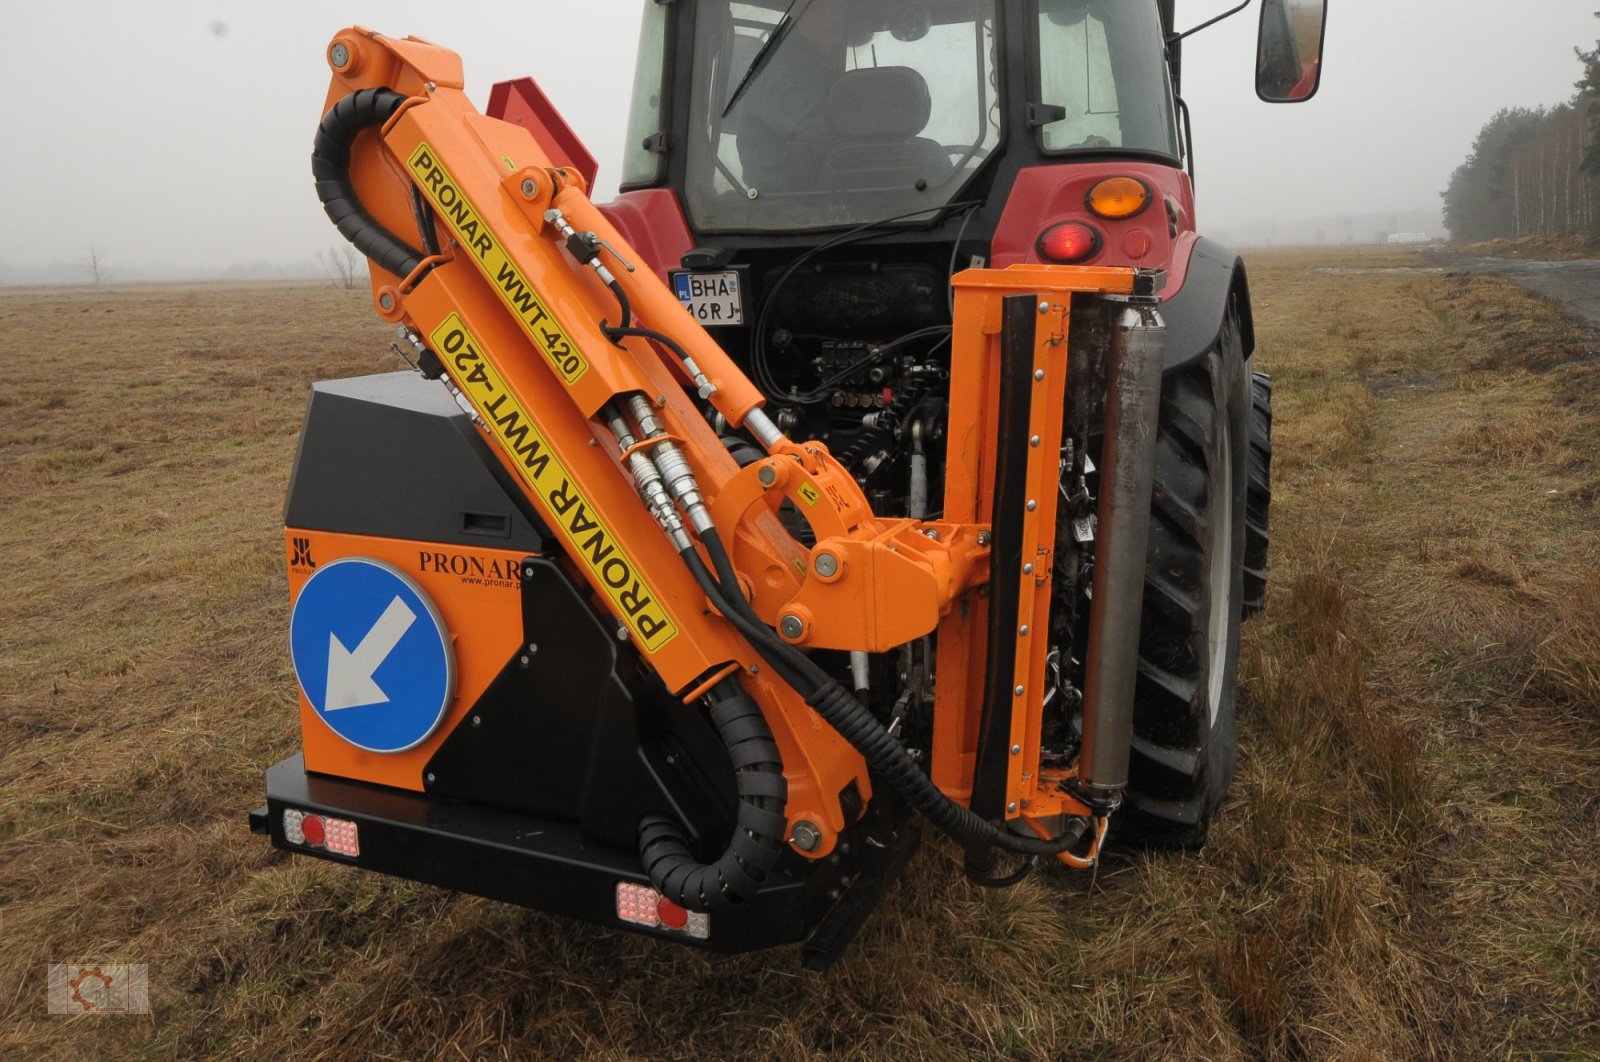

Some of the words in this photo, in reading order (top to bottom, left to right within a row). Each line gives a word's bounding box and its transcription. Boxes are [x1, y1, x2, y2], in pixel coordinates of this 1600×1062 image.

[413, 150, 493, 260] PRONAR
[496, 261, 580, 375] WWT-420
[679, 290, 690, 299] PL
[692, 278, 729, 297] BHA
[442, 328, 550, 480] WWT-420
[419, 551, 522, 581] PRONAR
[548, 478, 668, 641] PRONAR
